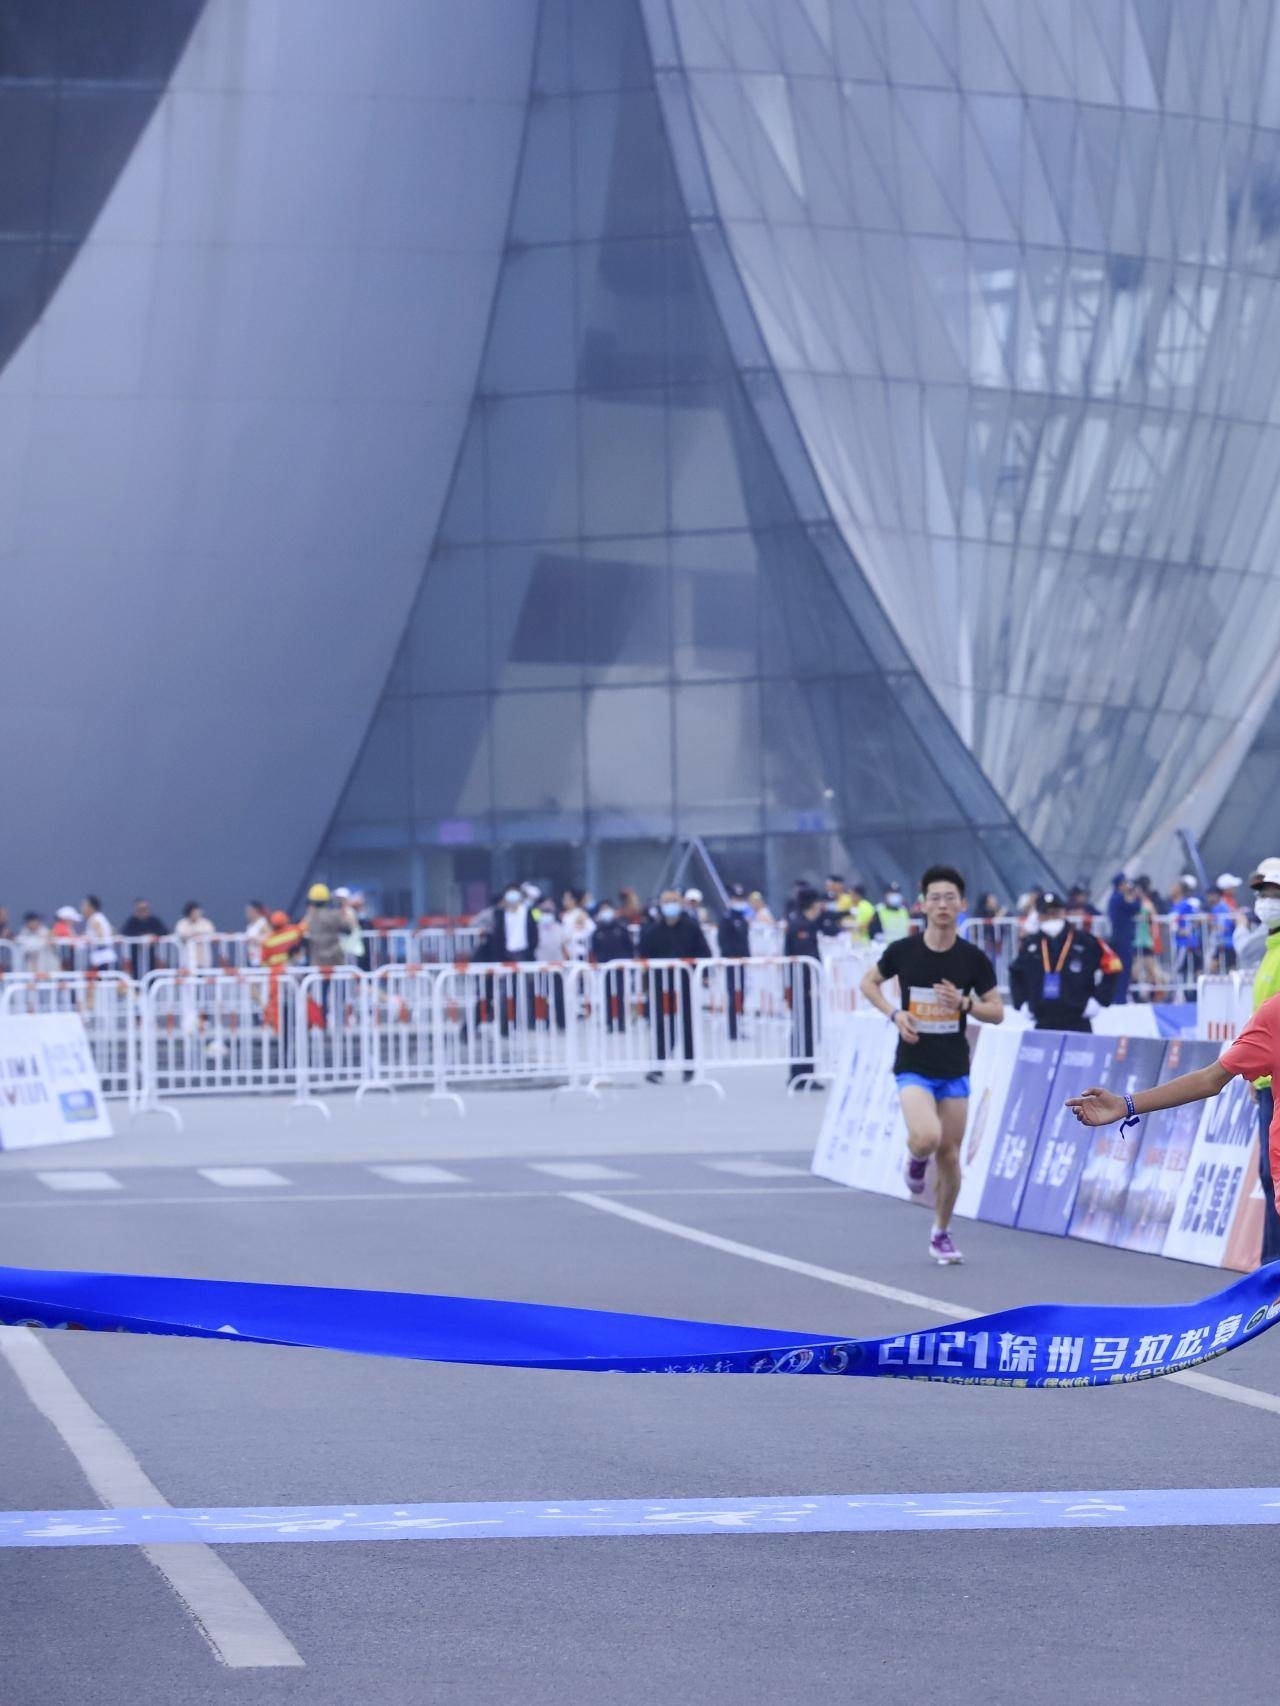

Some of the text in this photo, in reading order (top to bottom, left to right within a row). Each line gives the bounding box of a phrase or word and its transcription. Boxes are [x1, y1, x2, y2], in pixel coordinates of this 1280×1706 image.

[878, 1313, 1244, 1374] 2021徐州马拉松赛
